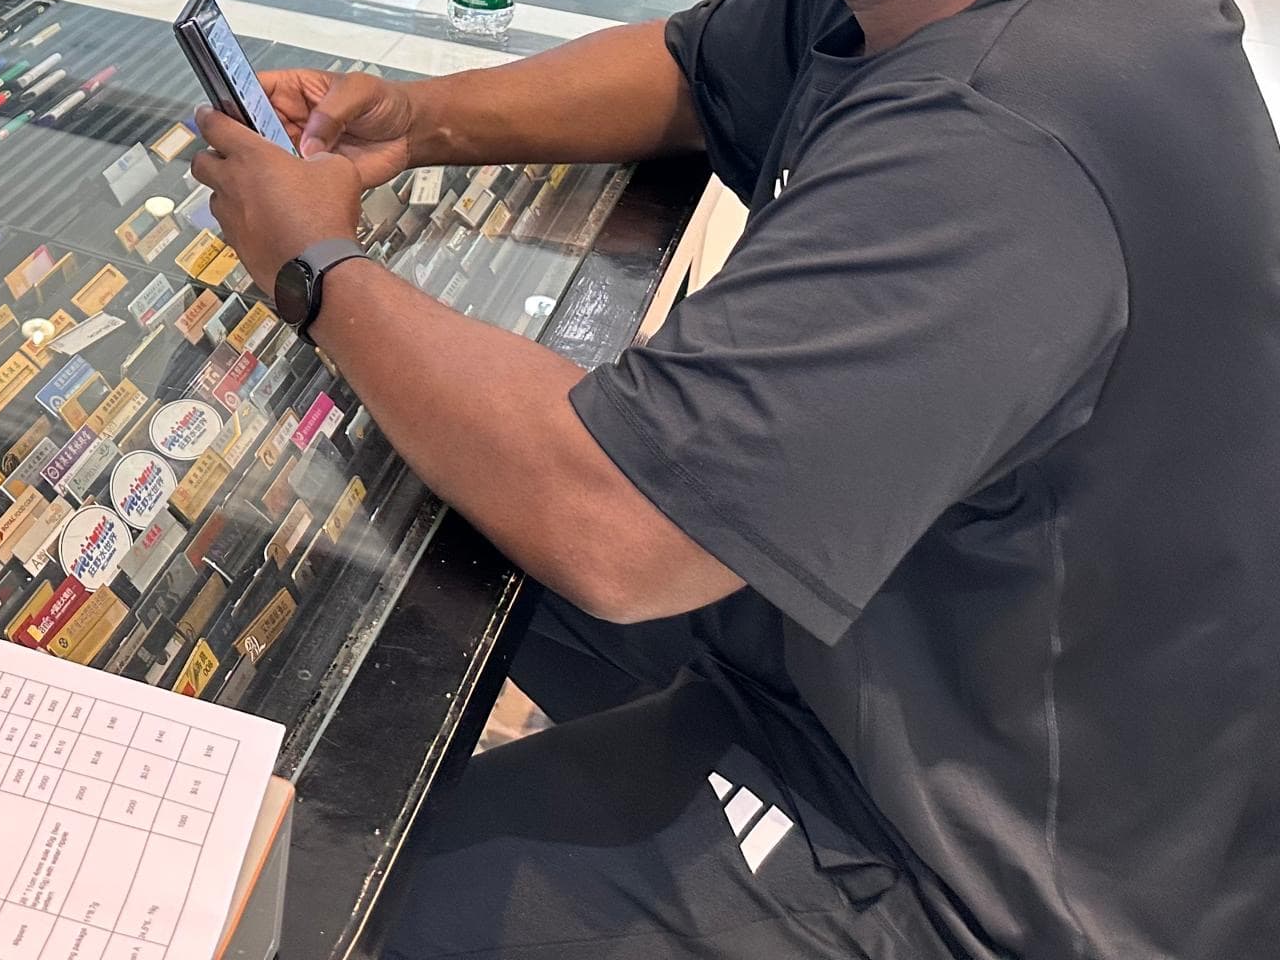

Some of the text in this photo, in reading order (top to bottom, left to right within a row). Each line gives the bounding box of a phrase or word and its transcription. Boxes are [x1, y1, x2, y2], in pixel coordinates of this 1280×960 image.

[0, 514, 16, 532] ROYAL
[13, 504, 26, 518] FOOD
[22, 491, 37, 508] COURT
